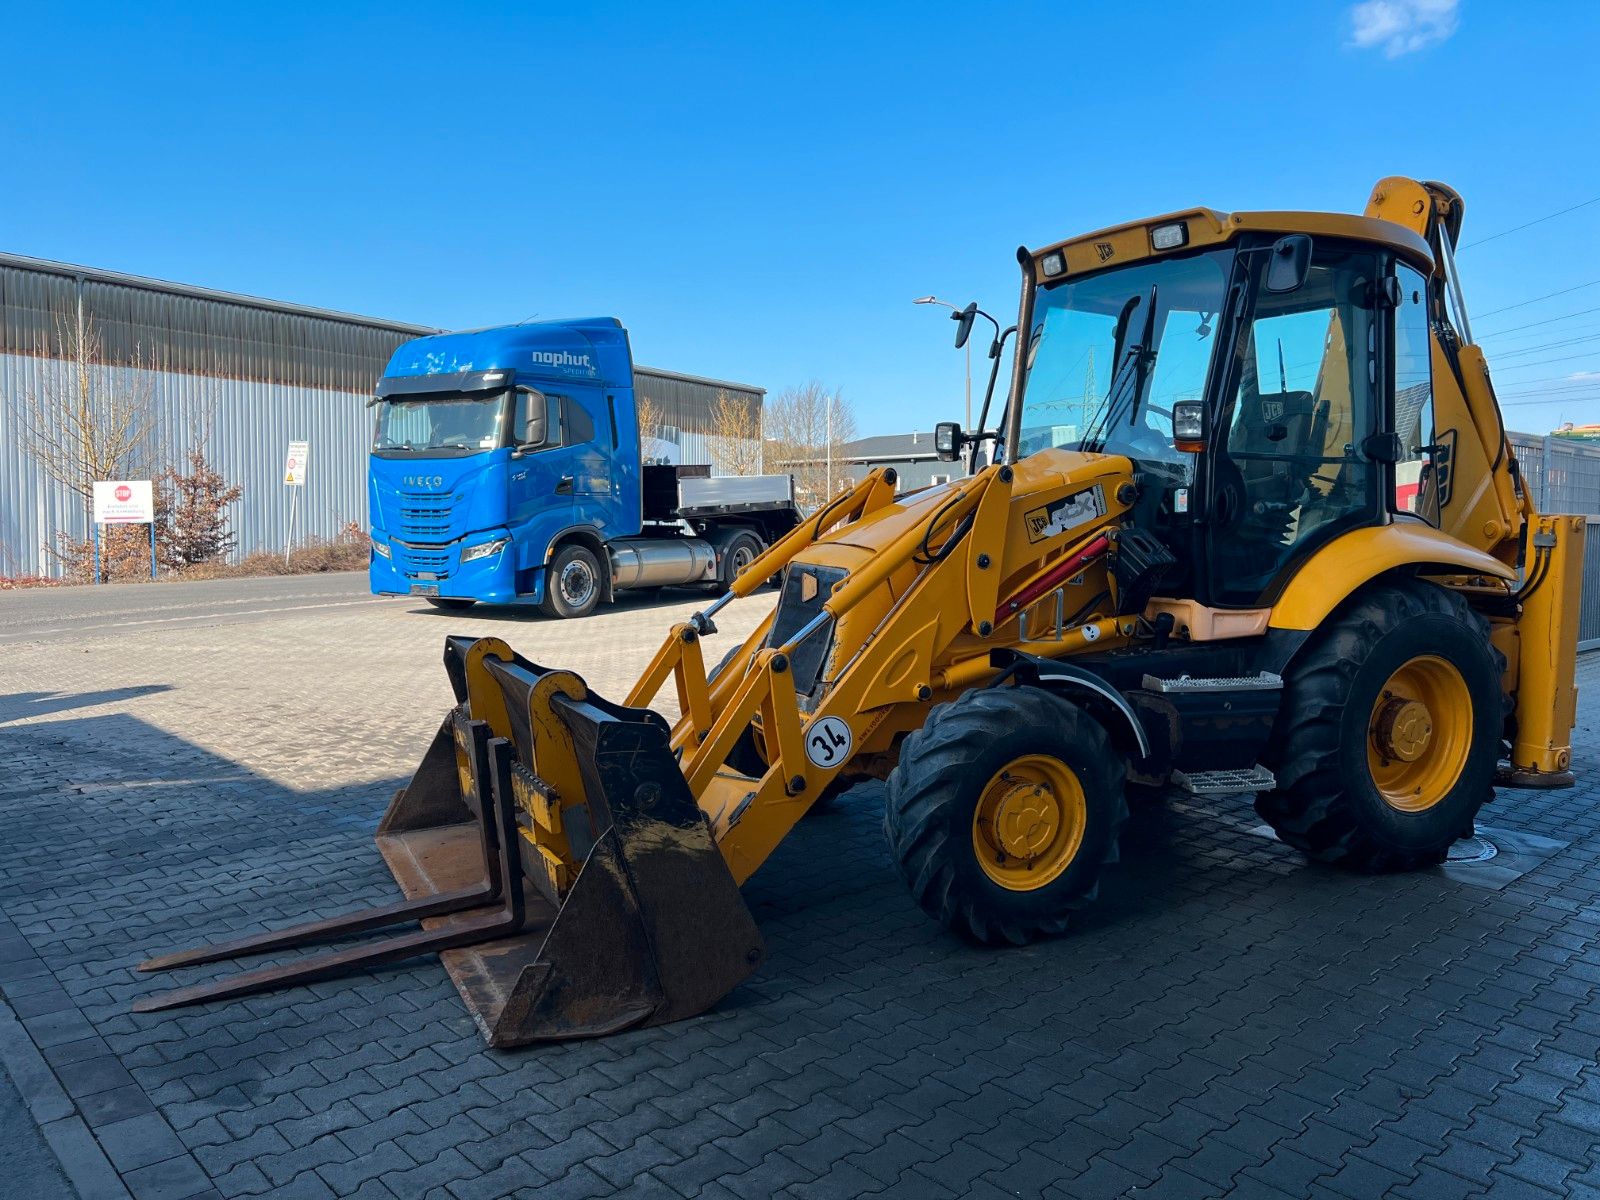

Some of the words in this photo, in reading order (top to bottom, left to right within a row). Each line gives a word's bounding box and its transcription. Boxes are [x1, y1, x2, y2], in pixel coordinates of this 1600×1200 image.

[1096, 243, 1113, 261] JCB
[1264, 403, 1282, 419] JCB
[403, 475, 442, 487] IVECO
[115, 489, 131, 497] STOP
[1030, 517, 1049, 533] JCB
[812, 724, 847, 762] 34
